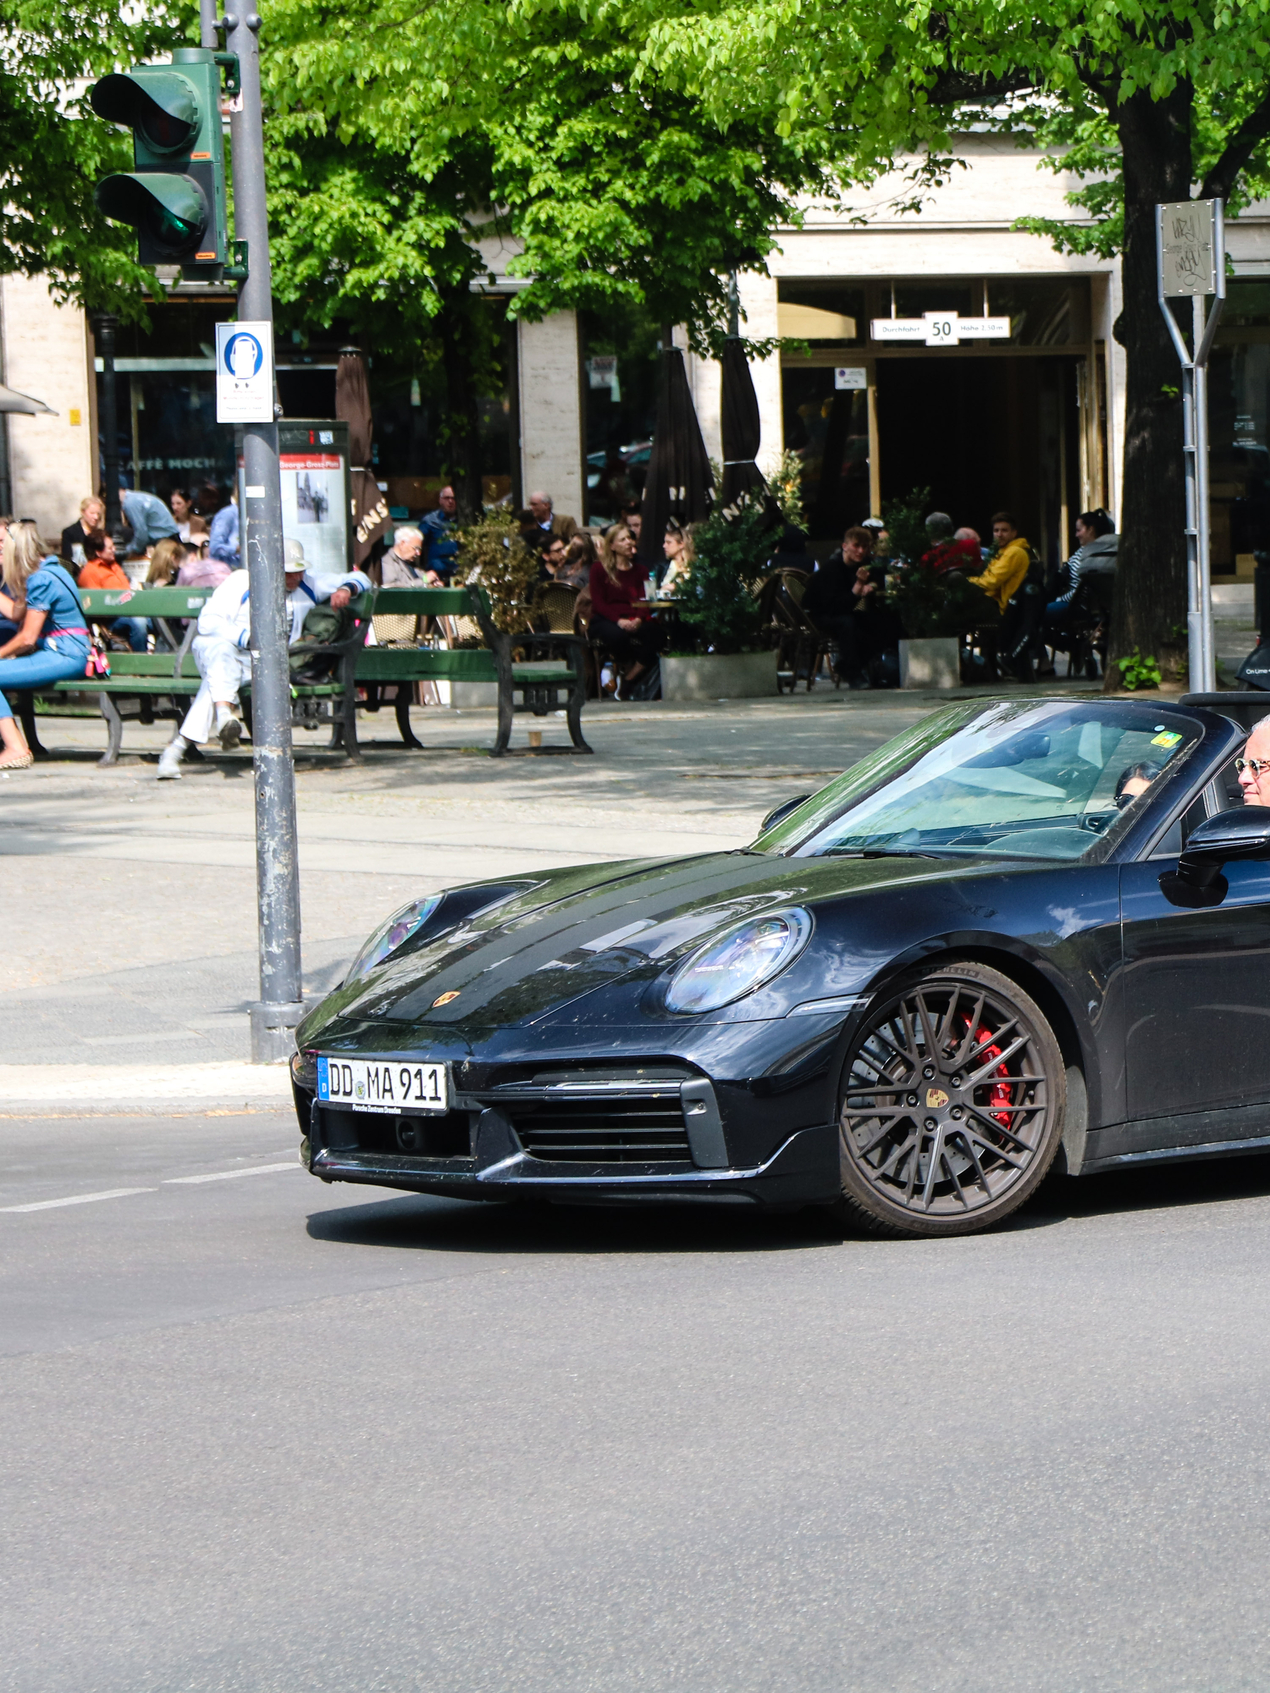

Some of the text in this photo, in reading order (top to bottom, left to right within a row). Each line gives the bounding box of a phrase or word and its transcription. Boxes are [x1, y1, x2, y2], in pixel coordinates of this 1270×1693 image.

[932, 321, 952, 337] 50
[329, 1063, 441, 1101] DD MA 911
